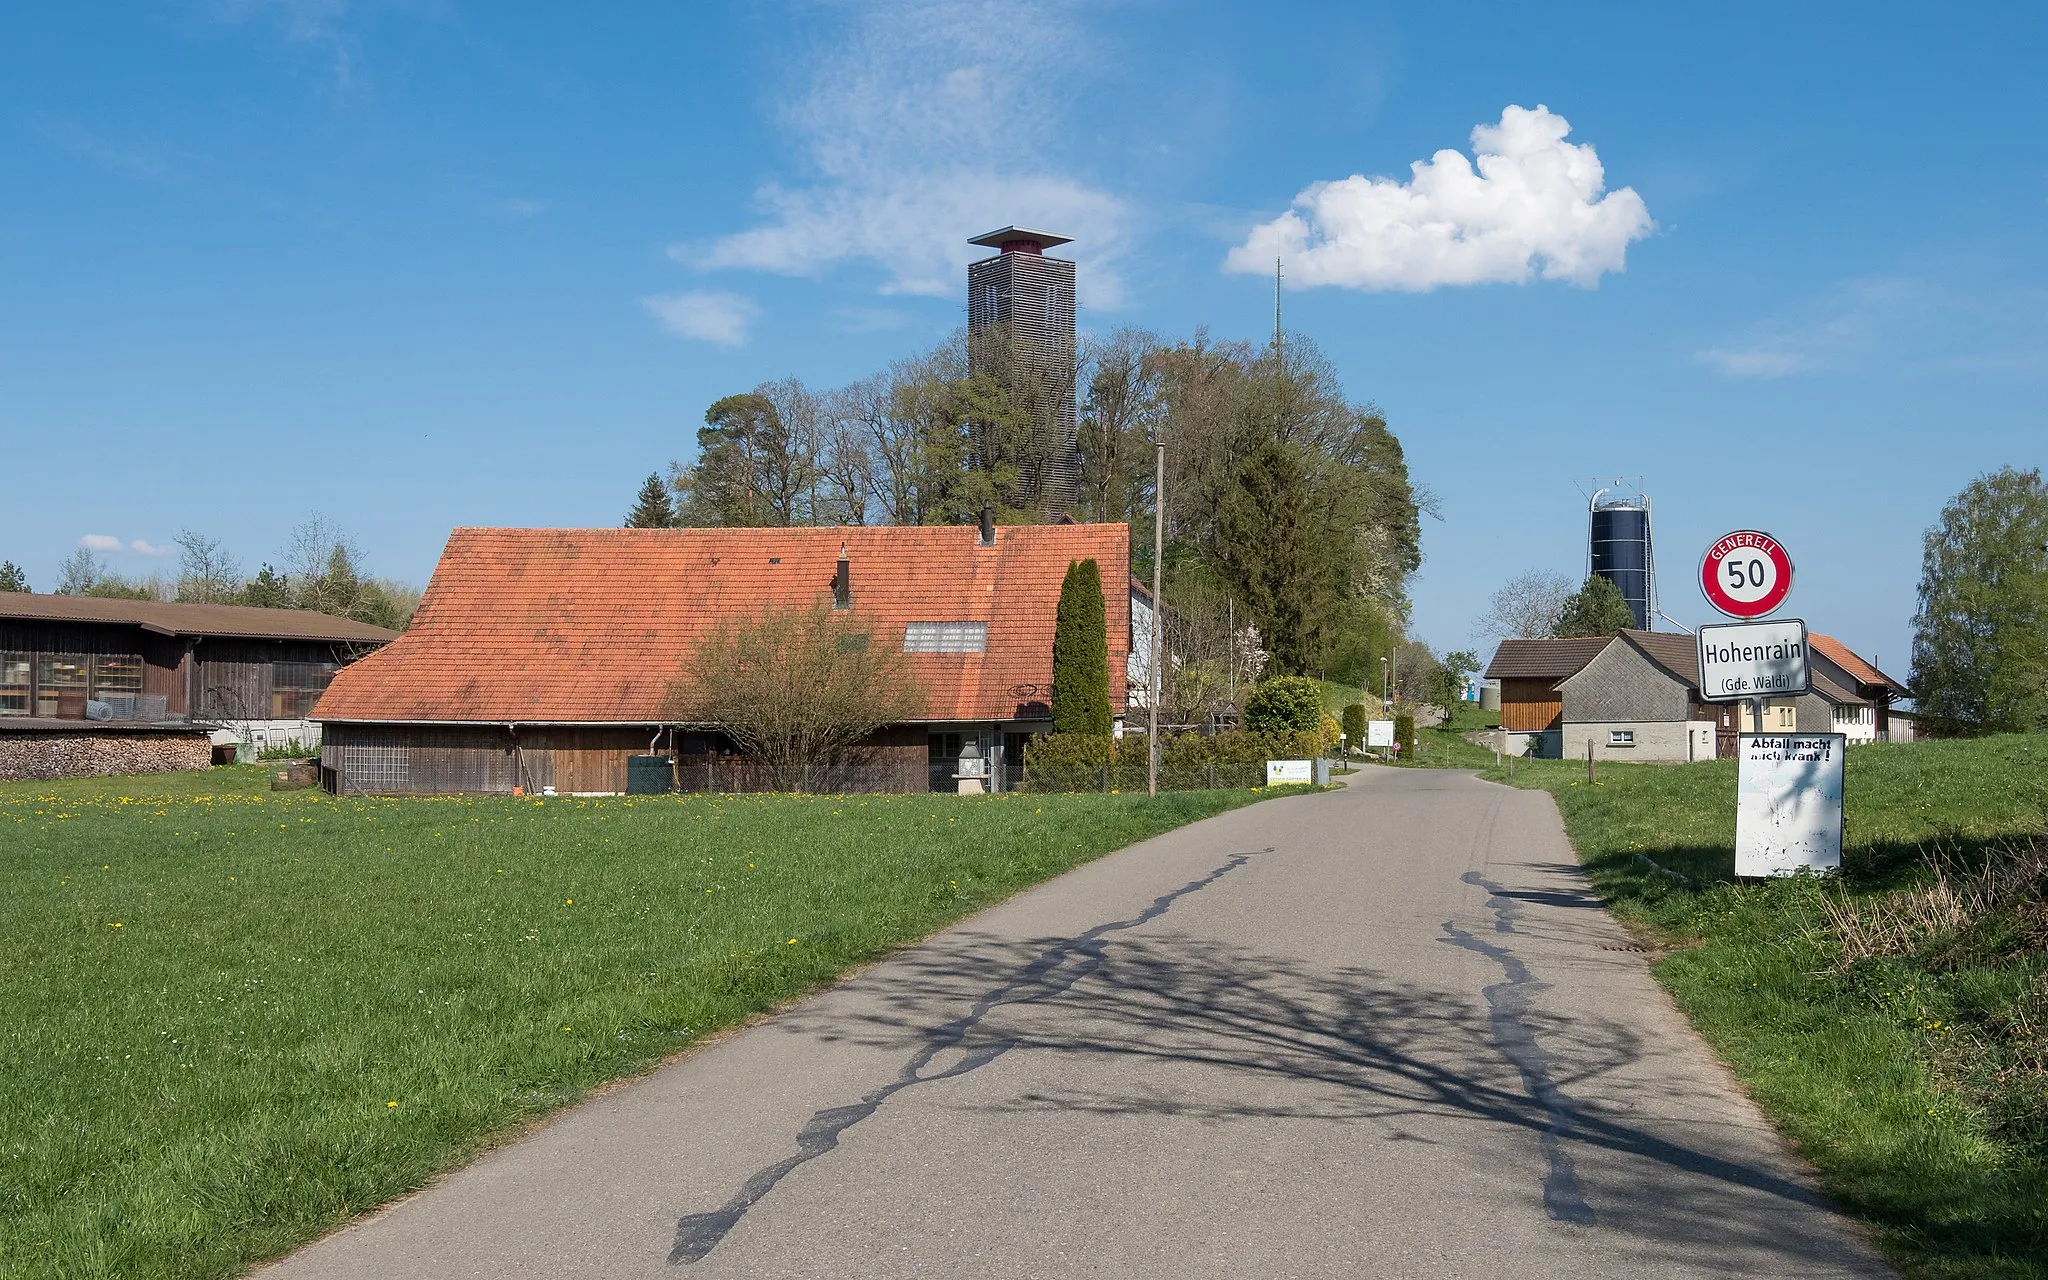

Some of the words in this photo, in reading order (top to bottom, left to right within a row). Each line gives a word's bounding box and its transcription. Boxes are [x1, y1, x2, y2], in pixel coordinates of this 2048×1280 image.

[1711, 534, 1776, 560] GENERELL
[1727, 559, 1765, 589] 50
[1705, 638, 1801, 664] Hohenrain
[1721, 678, 1751, 693] (Gde.
[1753, 674, 1790, 690] Wäldi)
[1751, 738, 1790, 749] Abfall
[1793, 739, 1831, 750] macht
[1784, 751, 1821, 762] krank
